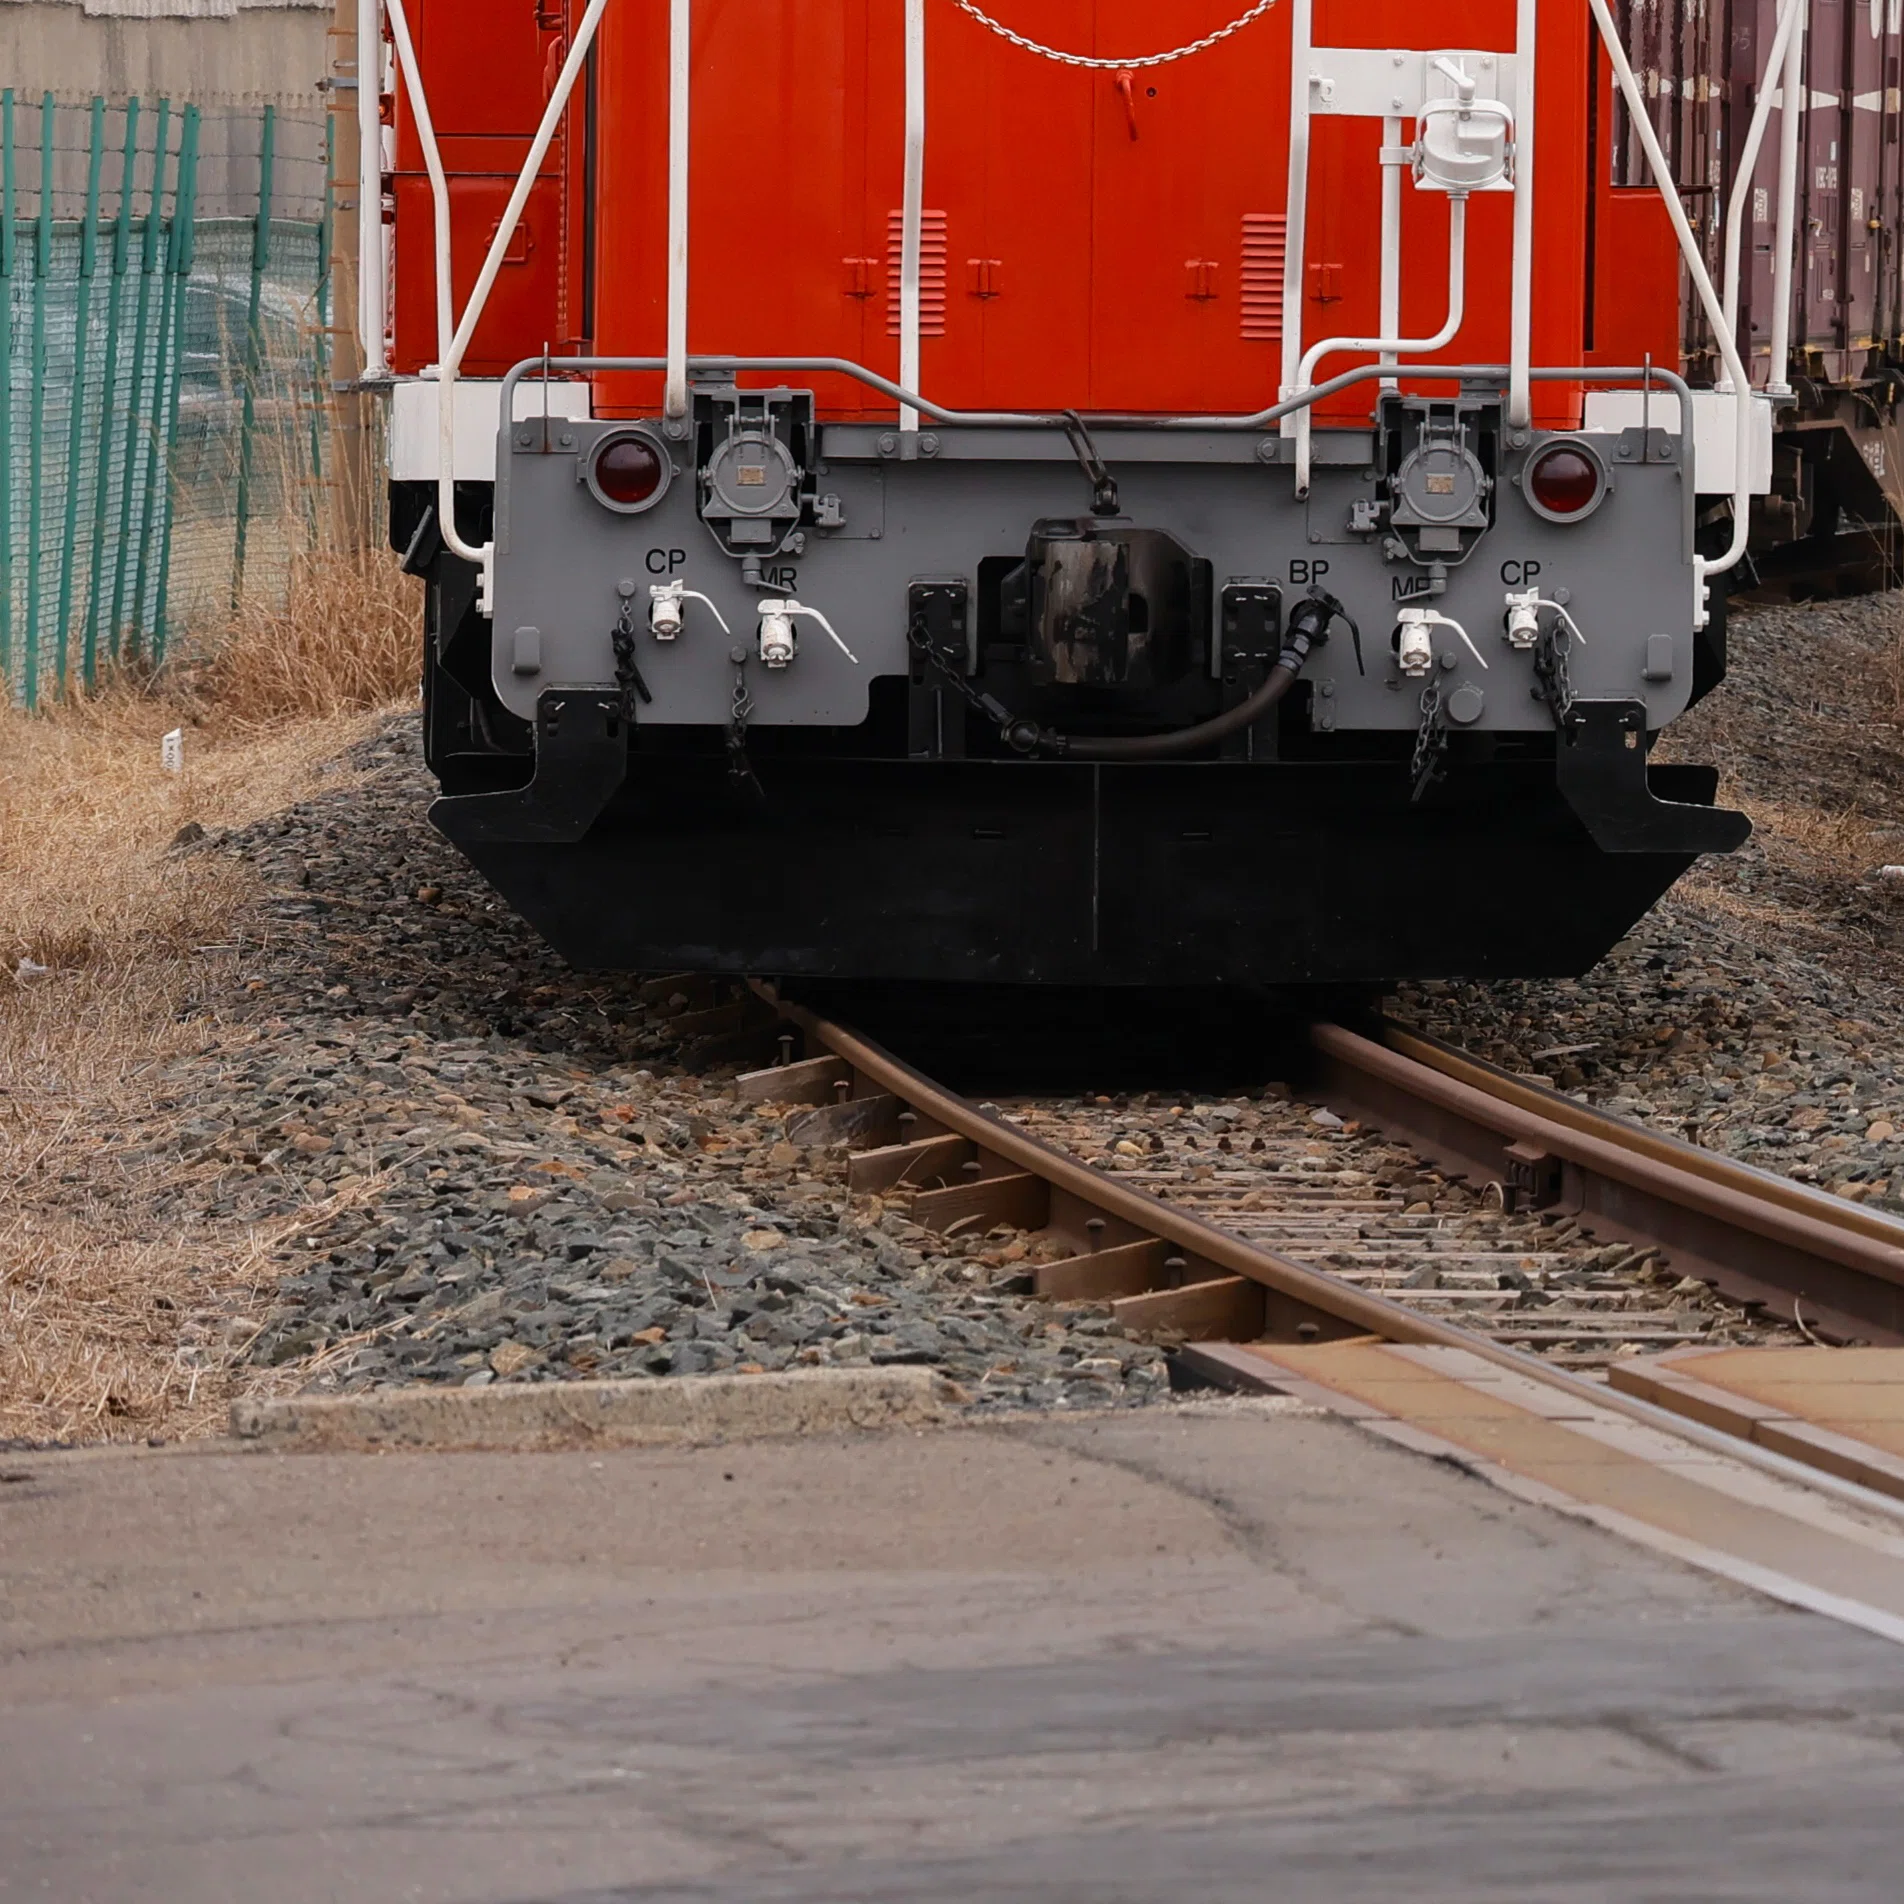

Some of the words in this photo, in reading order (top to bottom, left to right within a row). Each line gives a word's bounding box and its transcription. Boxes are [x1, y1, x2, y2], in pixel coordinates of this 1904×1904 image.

[645, 548, 687, 574] CP
[1288, 559, 1330, 585] BP
[1500, 560, 1541, 585] CP
